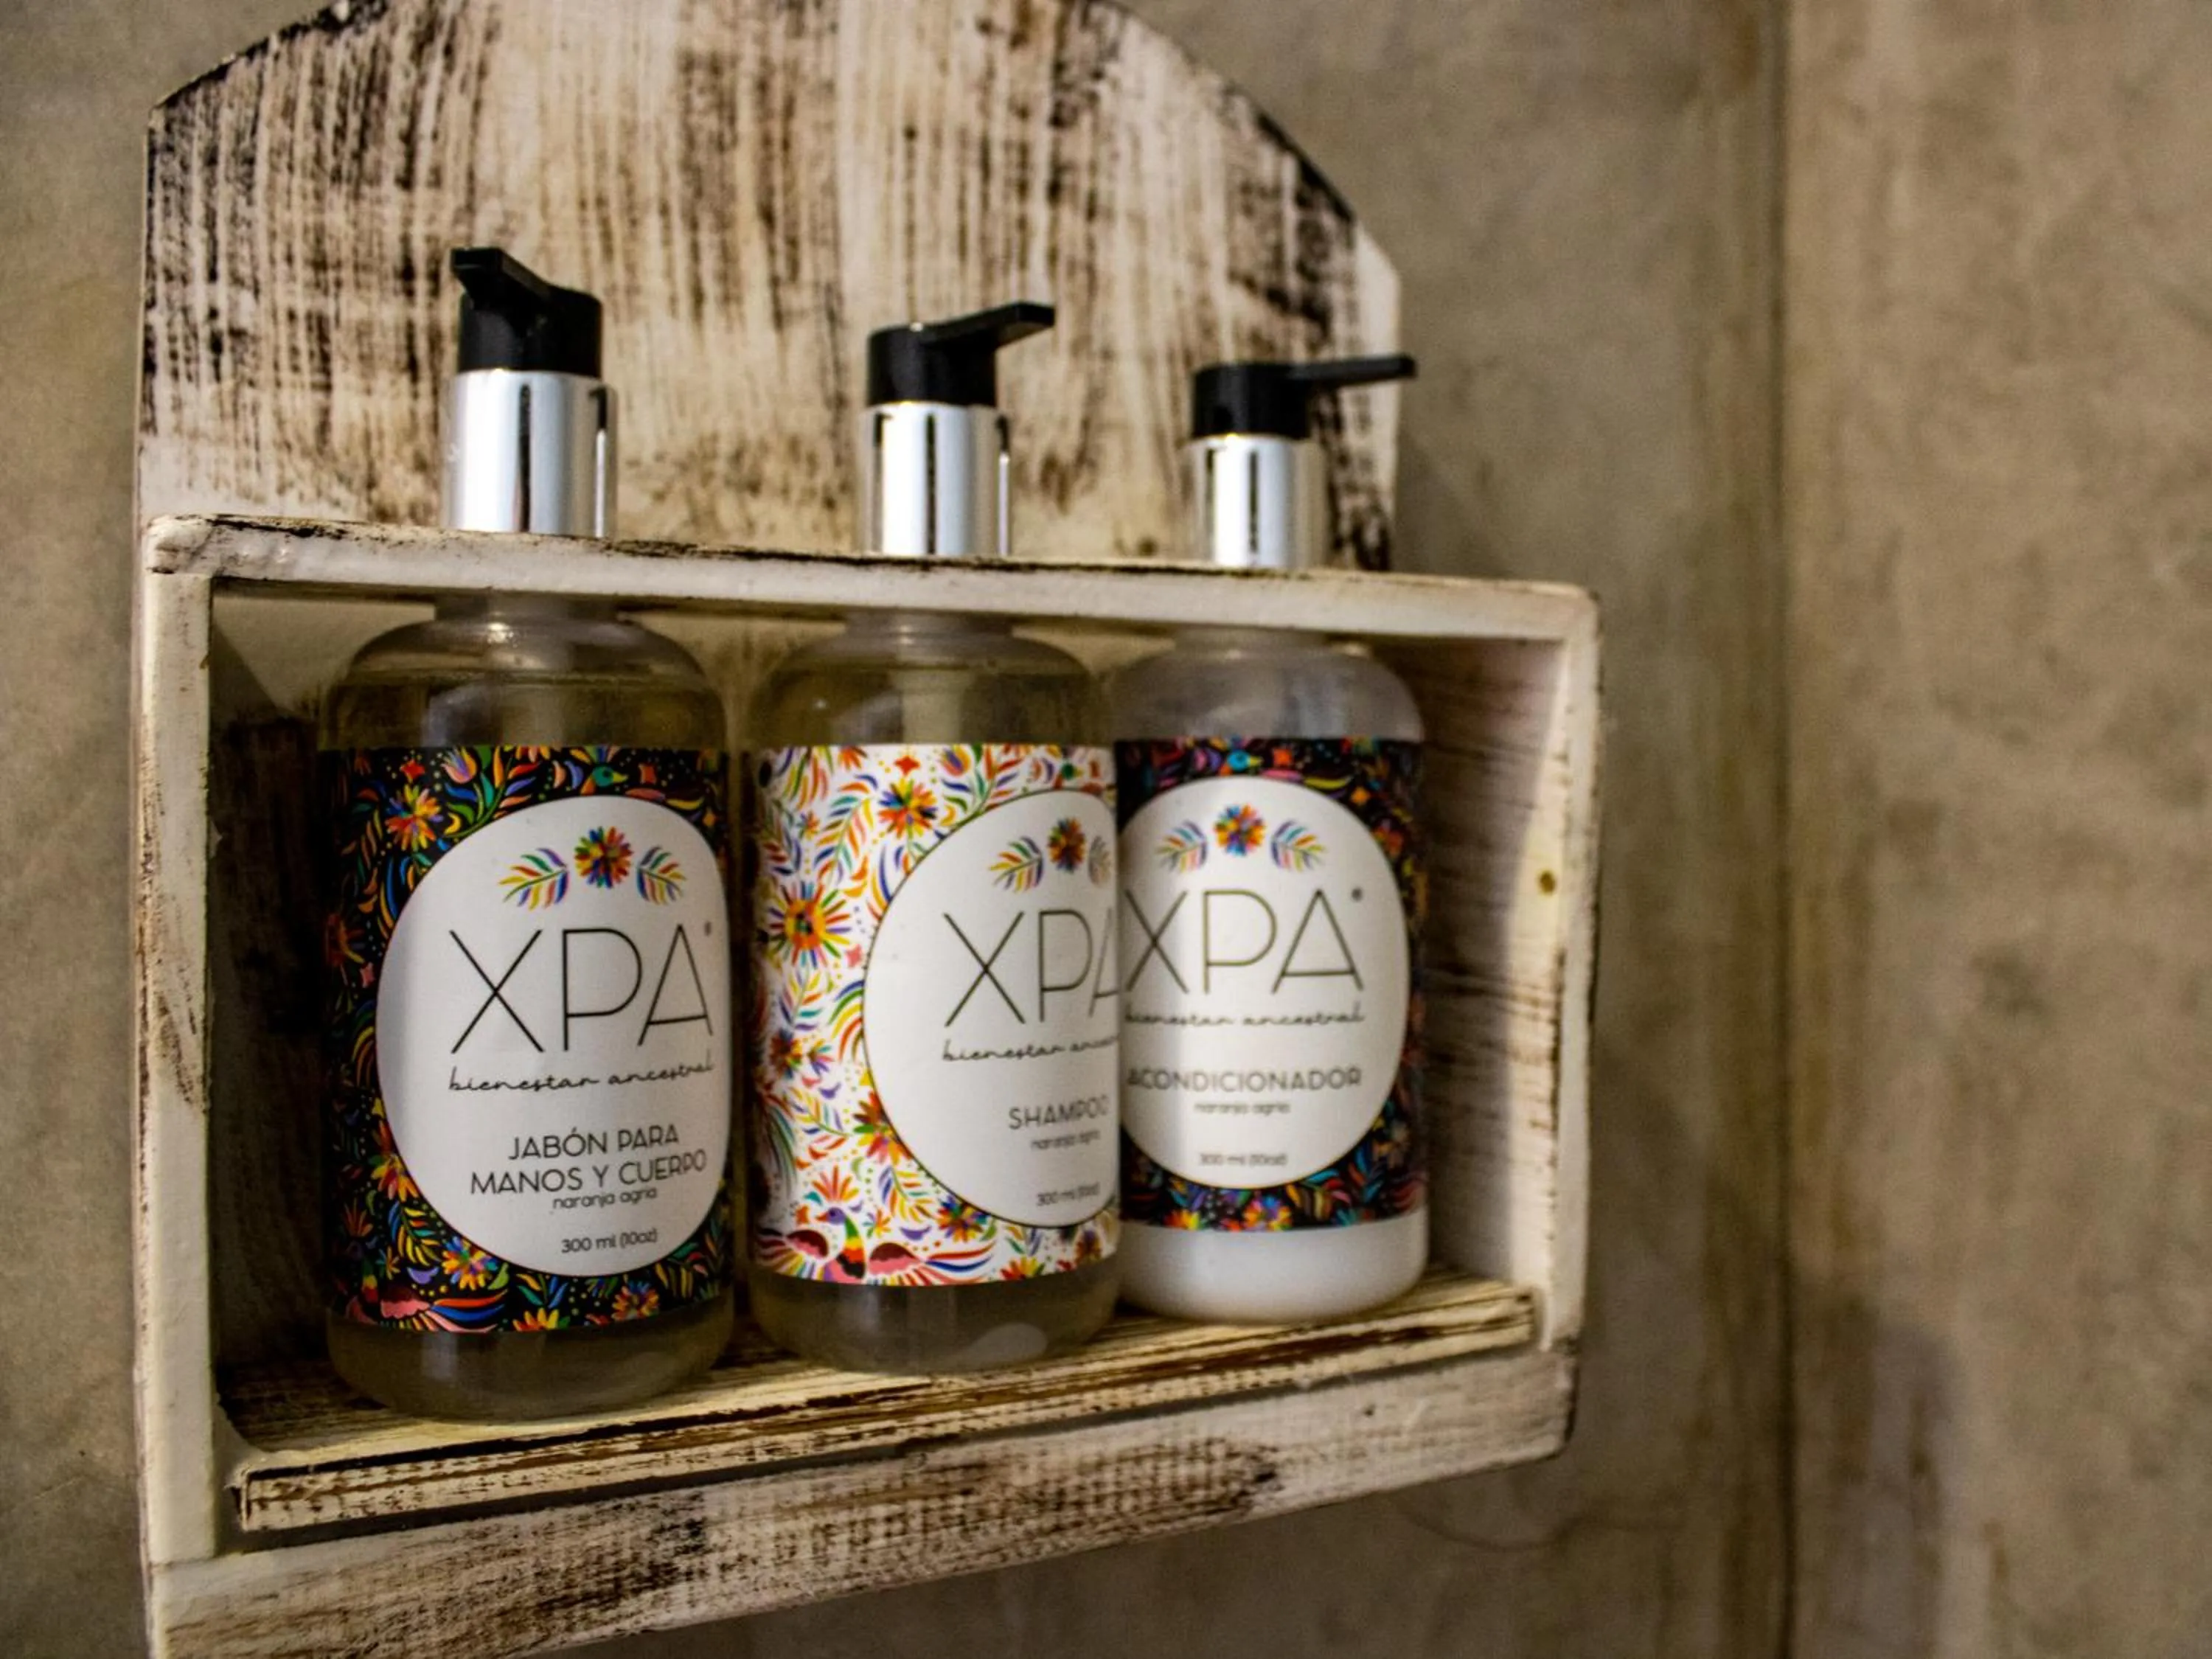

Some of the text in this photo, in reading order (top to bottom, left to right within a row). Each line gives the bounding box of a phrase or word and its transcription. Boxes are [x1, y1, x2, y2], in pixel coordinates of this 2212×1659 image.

[1124, 888, 1364, 995] XPA
[449, 923, 714, 1055] XPA
[448, 1047, 715, 1092] bienestar ancestral
[1127, 1067, 1363, 1093] ACONDICIONADOR
[508, 1123, 680, 1161] JABÓN PARA
[470, 1148, 709, 1195] MANOS Y CUERPO
[552, 1186, 658, 1211] naranja agria
[560, 1237, 592, 1253] 300
[596, 1232, 616, 1250] ml
